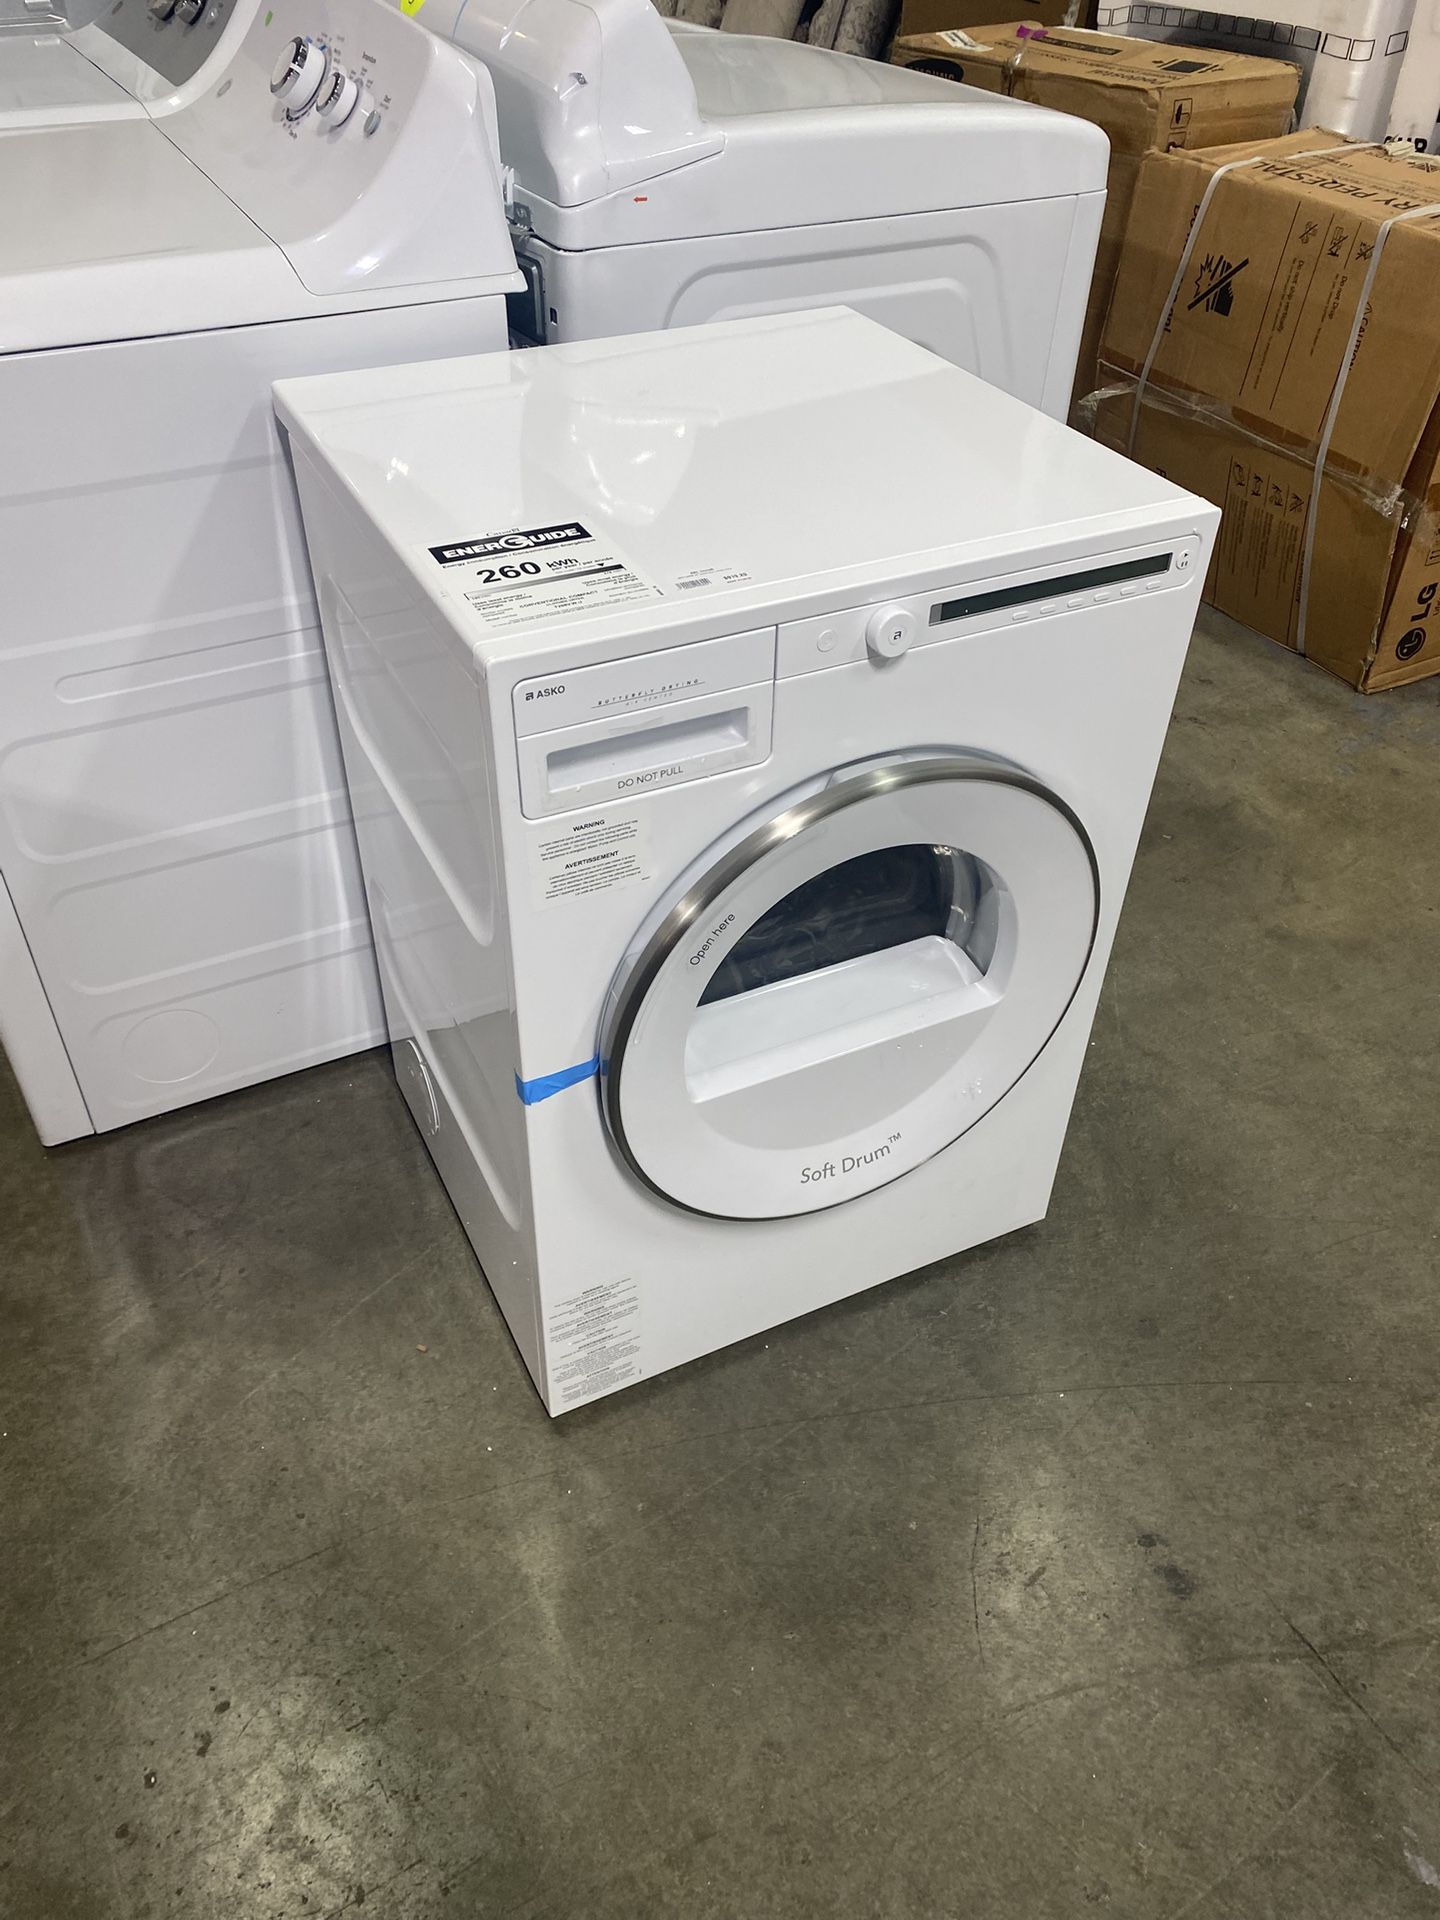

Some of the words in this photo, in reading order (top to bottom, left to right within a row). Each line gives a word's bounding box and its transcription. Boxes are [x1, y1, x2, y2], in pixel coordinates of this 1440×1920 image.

[1252, 161, 1379, 199] PEDESTAL
[442, 527, 582, 560] ENERGUIDE
[475, 561, 542, 585] 260
[546, 558, 579, 568] kWh
[1410, 582, 1439, 622] LG
[536, 685, 566, 699] ASKO
[617, 778, 634, 790] DO
[636, 771, 658, 784] NOT
[660, 766, 684, 779] PULL
[572, 819, 605, 832] WARNING
[564, 850, 619, 870] AVERTISSEMENT
[689, 938, 715, 966] Open
[711, 913, 736, 937] here
[800, 1162, 836, 1184] Soft
